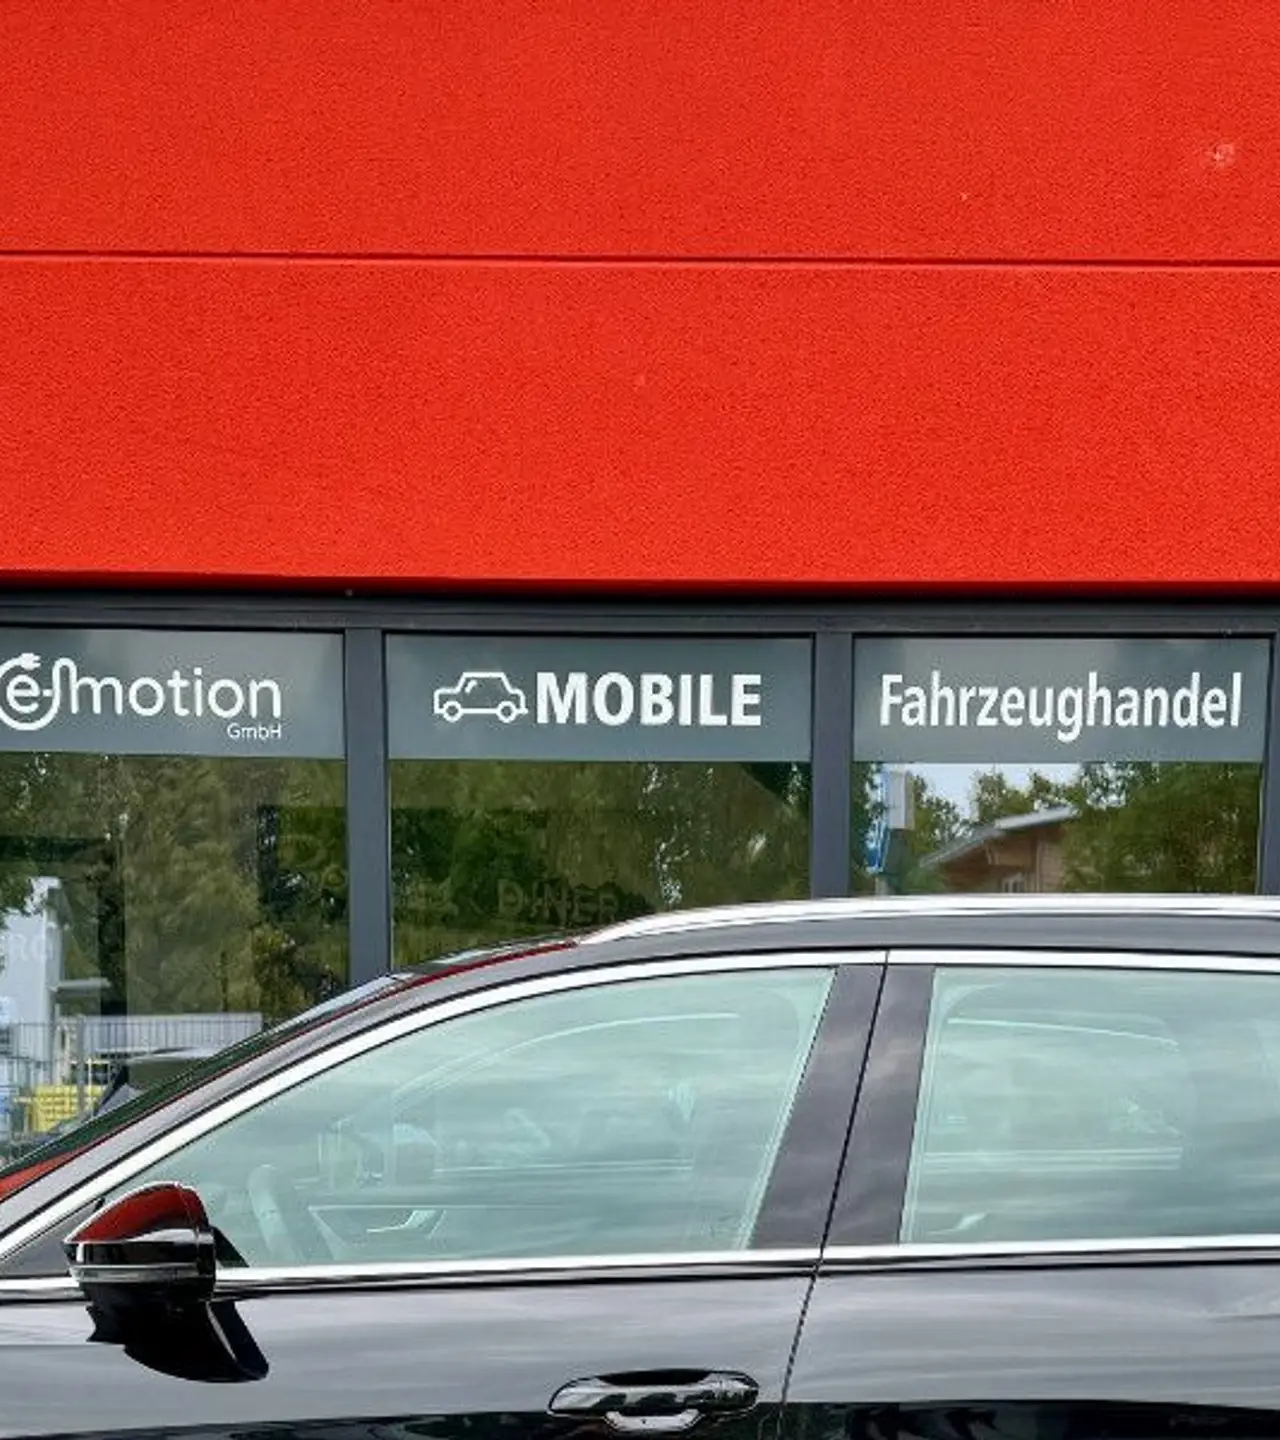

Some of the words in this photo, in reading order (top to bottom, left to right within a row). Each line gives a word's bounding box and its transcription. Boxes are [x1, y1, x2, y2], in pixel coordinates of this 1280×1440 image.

[536, 671, 762, 726] MOBILE
[879, 670, 1242, 743] Fahrzeughandel
[227, 722, 282, 740] GmbH
